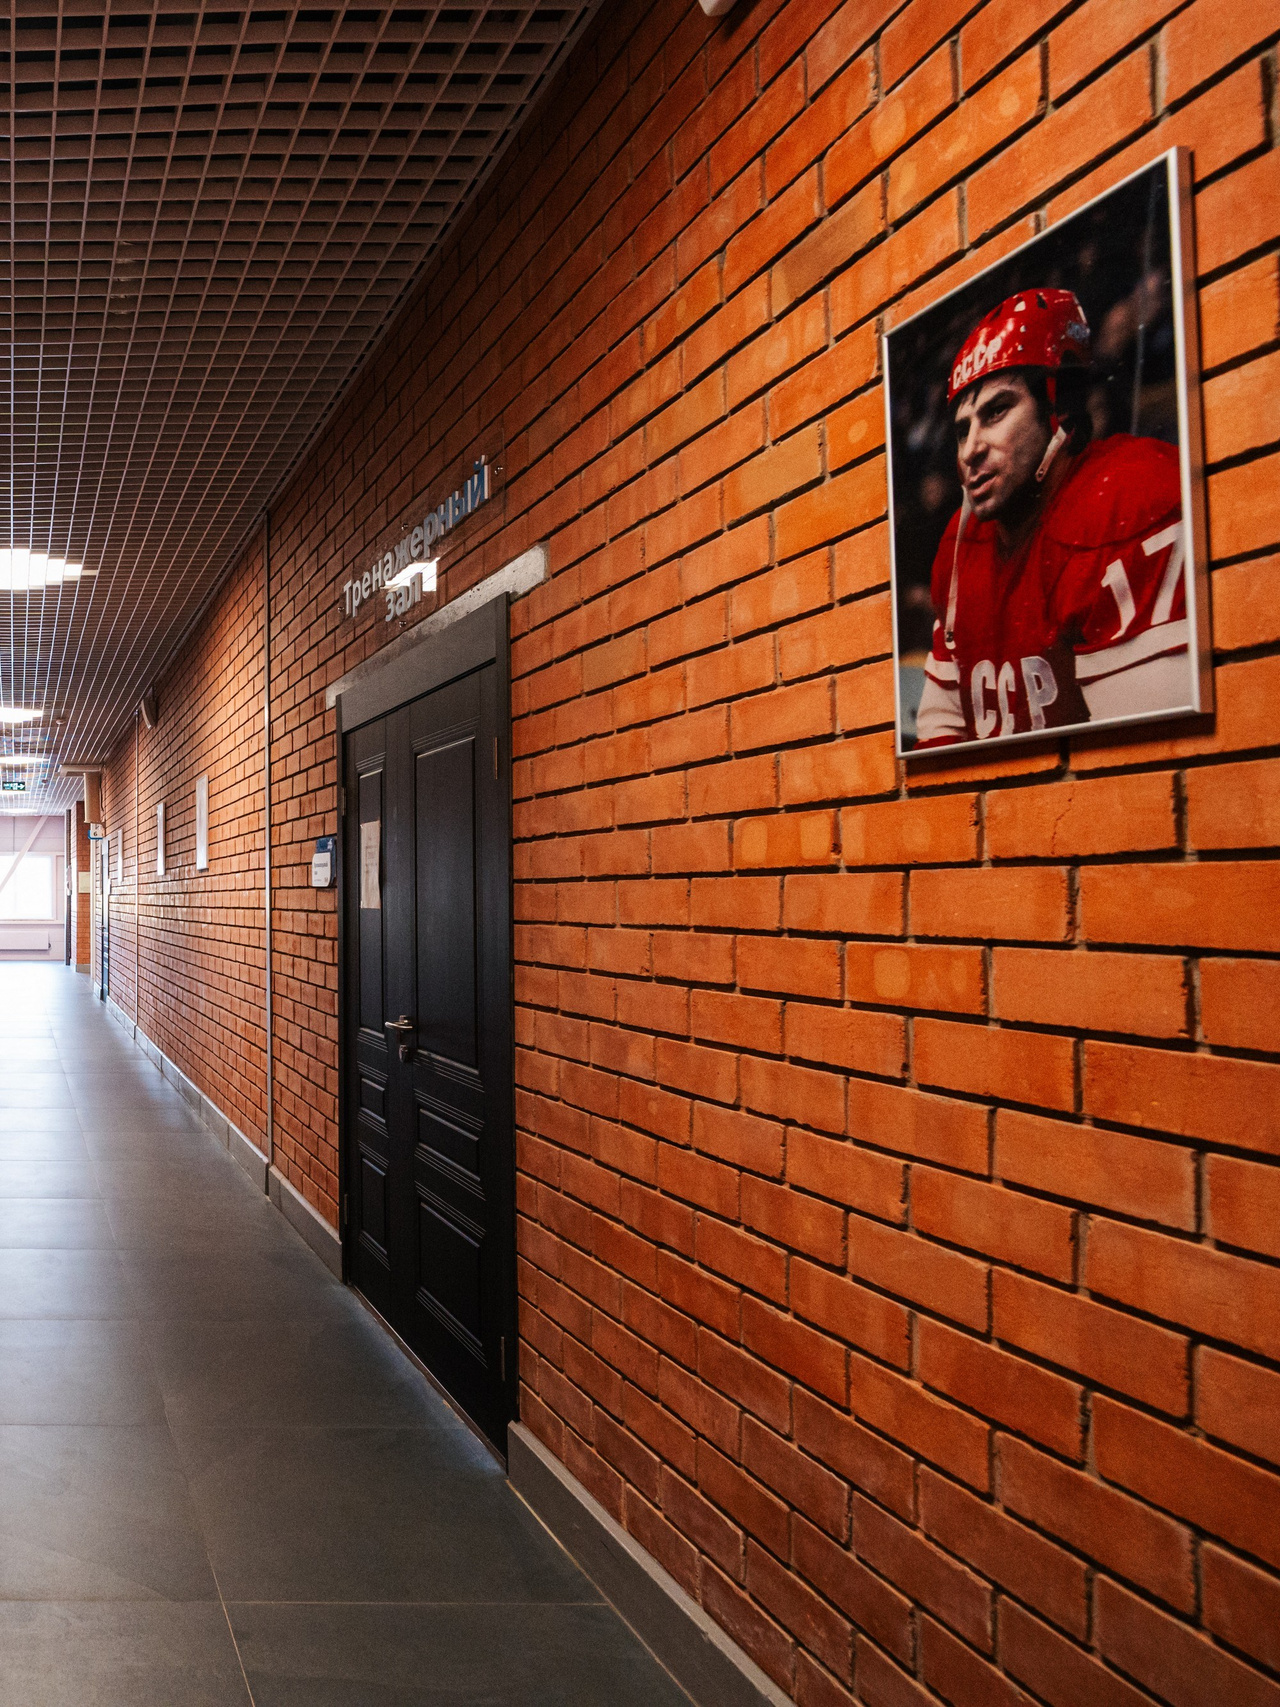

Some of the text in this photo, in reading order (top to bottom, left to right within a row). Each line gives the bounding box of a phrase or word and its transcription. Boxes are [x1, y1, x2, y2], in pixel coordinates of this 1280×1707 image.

[343, 455, 490, 618] Тренажерный
[385, 571, 423, 622] зал
[1101, 520, 1185, 640] 17
